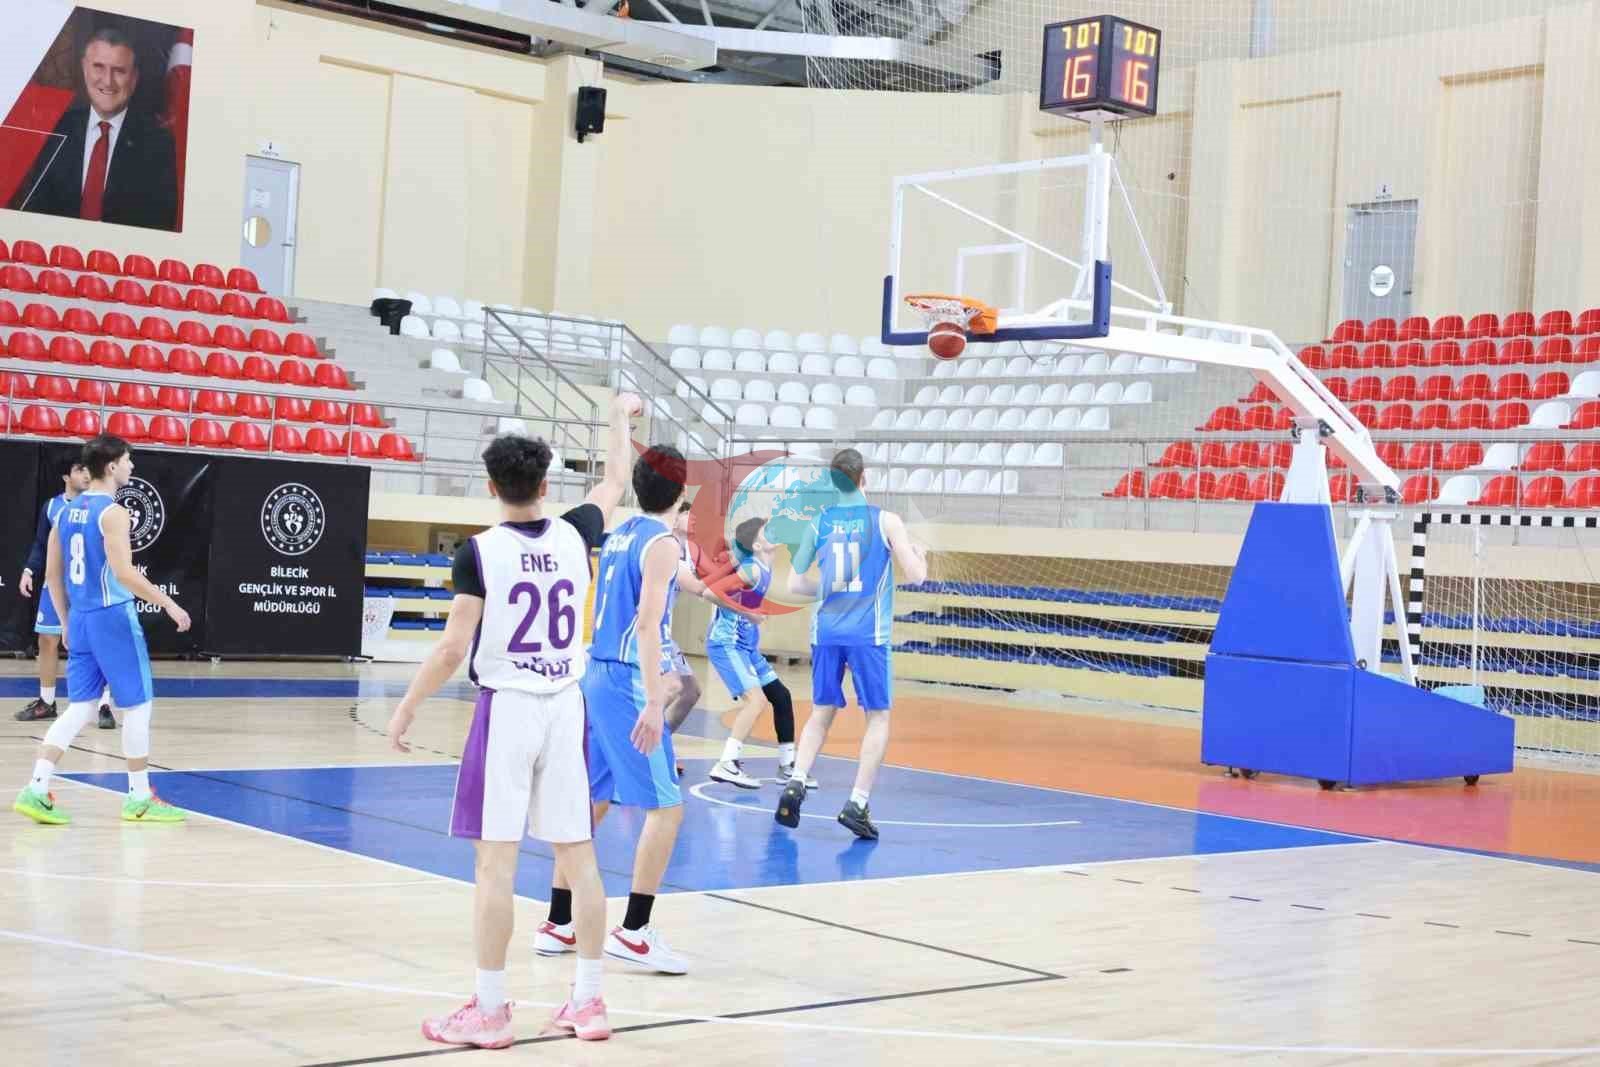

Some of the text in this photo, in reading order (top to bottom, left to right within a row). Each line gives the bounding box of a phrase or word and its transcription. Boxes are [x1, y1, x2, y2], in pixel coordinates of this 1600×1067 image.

[1062, 55, 1093, 99] 16
[1123, 60, 1149, 106] 16
[70, 533, 86, 585] 8
[271, 565, 309, 579] BİLECİK
[832, 542, 863, 592] 11
[239, 582, 337, 598] GENÇLİK VE SPOR İL
[253, 599, 321, 614] MÜDÜRLÜĞÜ
[507, 579, 575, 653] 26
